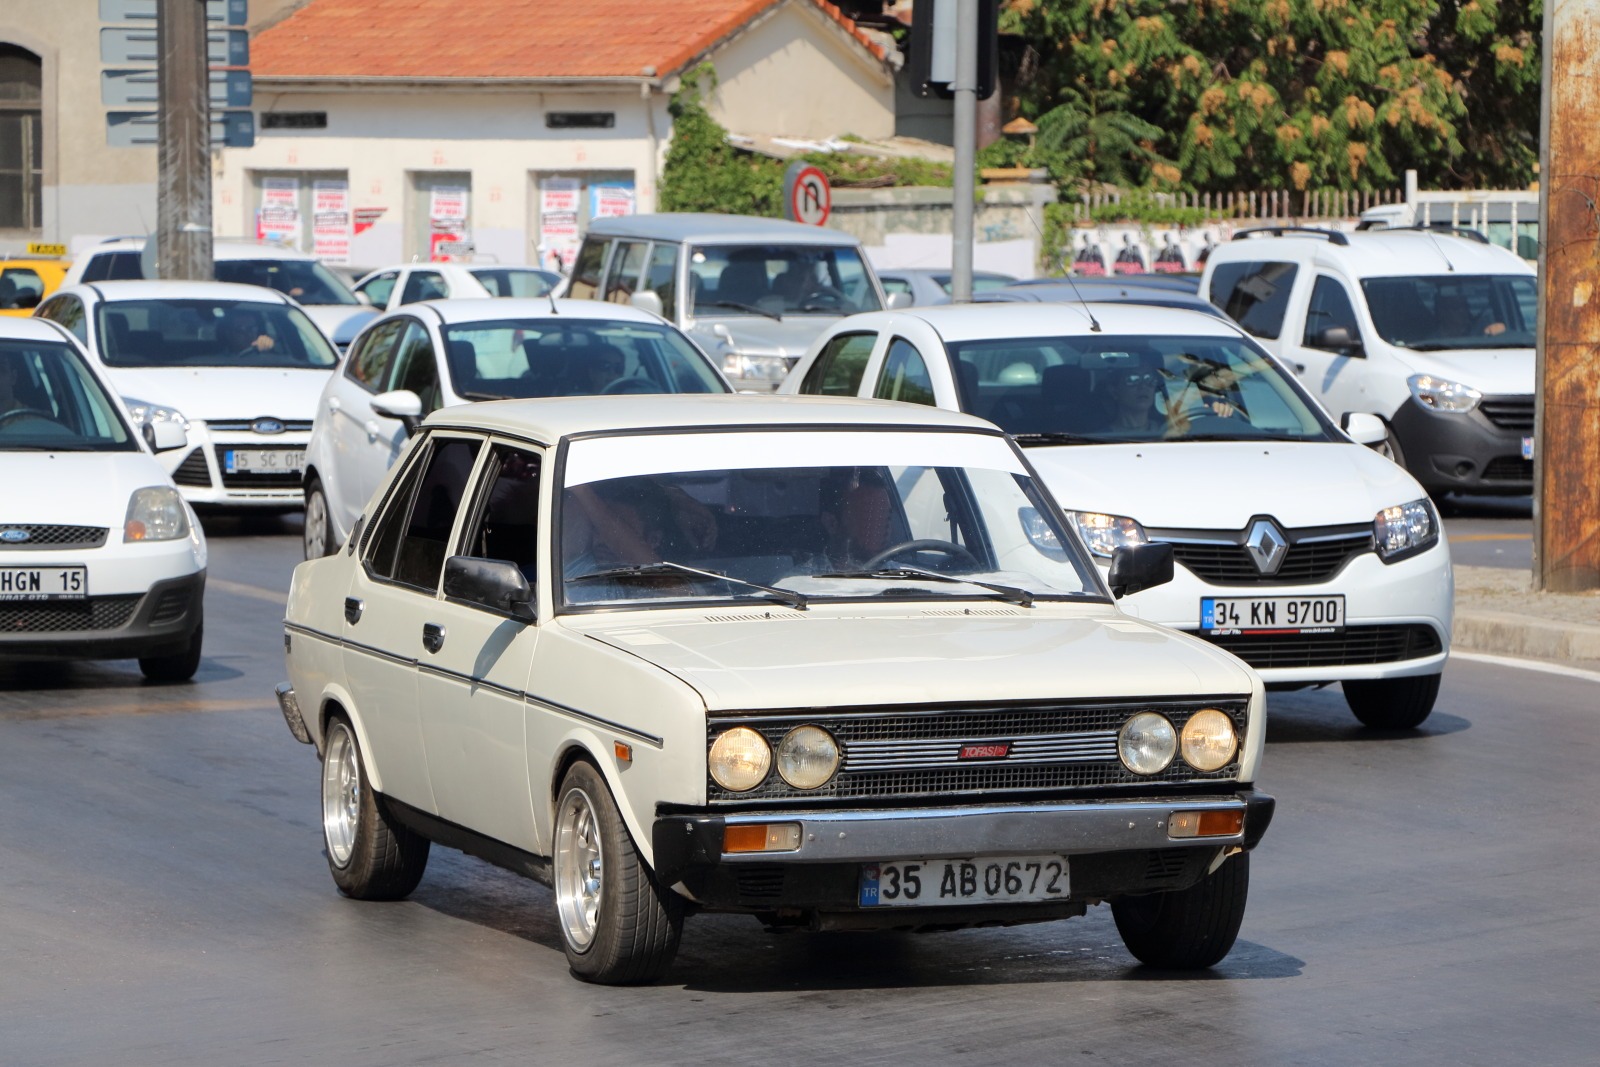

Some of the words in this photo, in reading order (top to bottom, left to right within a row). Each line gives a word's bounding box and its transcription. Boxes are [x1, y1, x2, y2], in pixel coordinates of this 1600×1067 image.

[260, 453, 276, 467] SC
[1, 571, 41, 591] HGN
[59, 571, 81, 591] 15
[1204, 615, 1214, 624] TR
[1215, 602, 1240, 625] 34
[1251, 601, 1276, 625] KN
[1287, 600, 1337, 624] 9700
[882, 865, 921, 900] 35
[864, 887, 877, 897] TR
